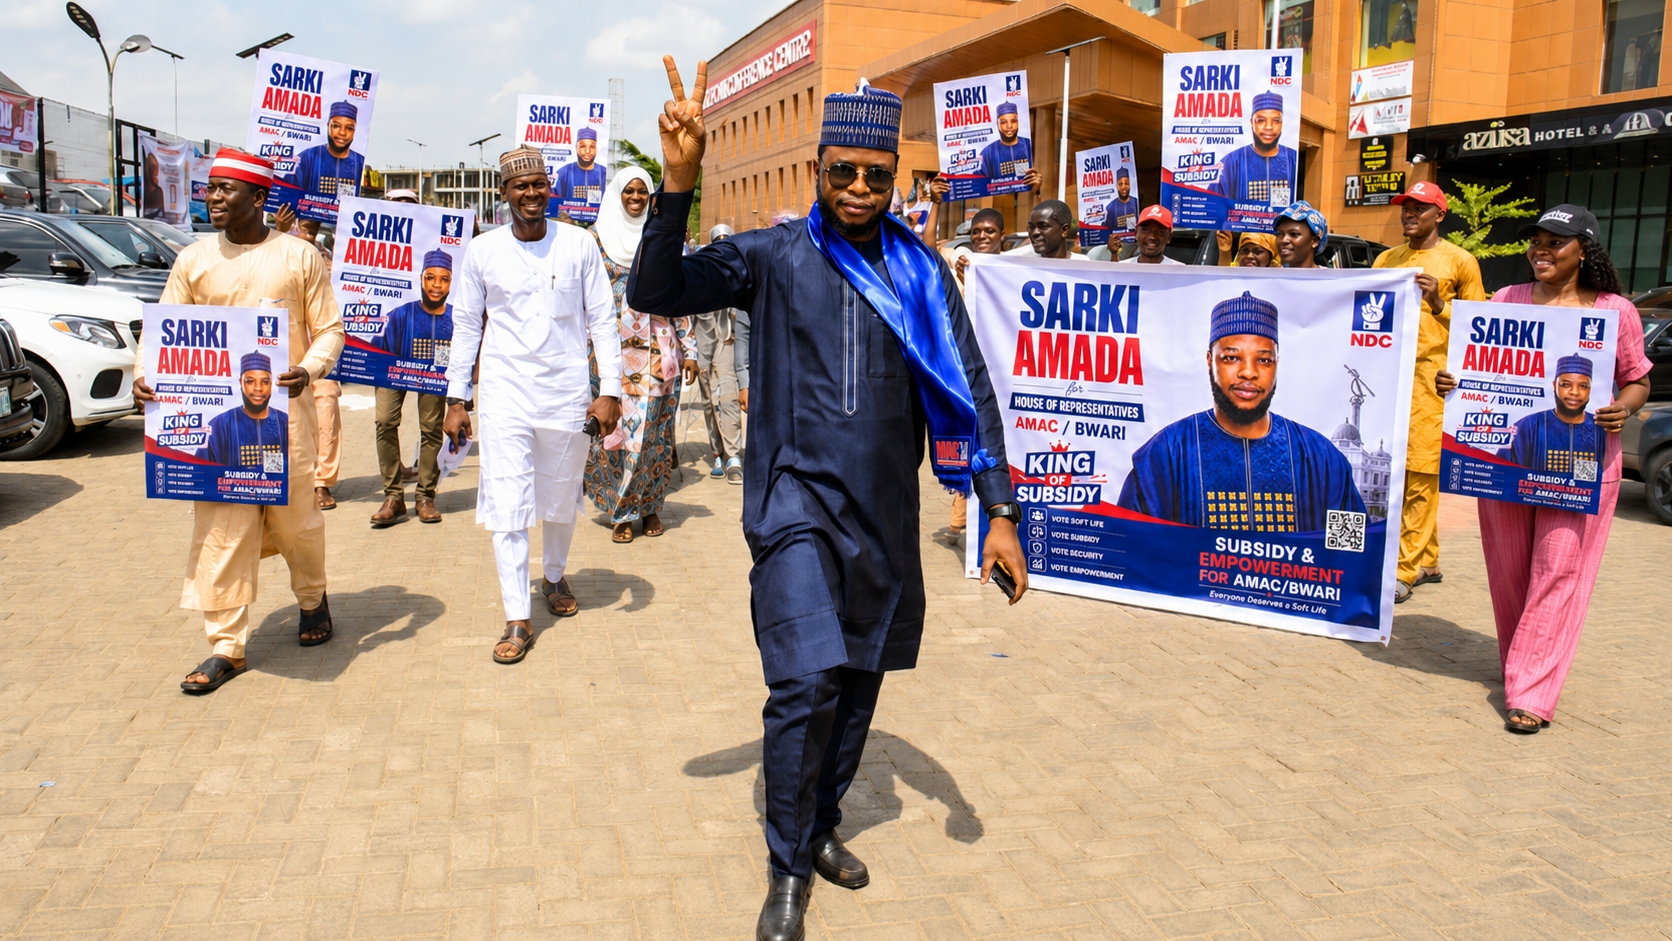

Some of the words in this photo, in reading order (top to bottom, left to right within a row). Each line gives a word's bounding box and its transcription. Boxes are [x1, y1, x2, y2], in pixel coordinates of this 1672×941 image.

[270, 63, 323, 94] SARKI
[1180, 65, 1240, 91] SARKI
[1271, 77, 1291, 85] NDC
[348, 89, 368, 98] NDC
[945, 85, 987, 108] SARKI
[262, 87, 321, 119] AMADA
[1174, 92, 1243, 118] AMADA
[529, 104, 570, 125] SARKI
[944, 105, 992, 129] AMADA
[524, 124, 572, 144] AMADA
[1175, 136, 1198, 144] AMAC
[1534, 126, 1584, 142] HOTEL
[262, 146, 291, 156] KING
[1084, 154, 1111, 173] SARKI
[1180, 154, 1212, 166] KING
[1082, 170, 1114, 188] AMADA
[352, 211, 413, 244] SARKI
[440, 237, 461, 246] NDC
[344, 238, 413, 272] AMADA
[342, 284, 365, 293] AMAC
[374, 288, 402, 298] BWARI
[345, 305, 378, 316] KING
[1020, 280, 1140, 334] SARKI
[161, 318, 227, 348] SARKI
[344, 322, 382, 332] UBSIDY
[1470, 316, 1545, 349] SARKI
[257, 338, 278, 346] NDC
[1350, 333, 1393, 348] NDC
[1579, 341, 1603, 350] NDC
[157, 347, 232, 377] AMADA
[1012, 330, 1144, 385] AMADA
[1462, 344, 1545, 378] AMADA
[1065, 381, 1084, 396] for
[158, 395, 183, 404] AMAC
[192, 397, 223, 406] BWARI
[1014, 396, 1044, 410] HOUSE
[1046, 399, 1058, 410] OF
[1059, 400, 1139, 419] REPRESENTATIVES
[1461, 392, 1488, 403] AMAC
[1498, 396, 1533, 407] BWARI
[165, 415, 199, 428] KING
[1015, 416, 1059, 433] AMAC
[1062, 421, 1070, 436] /
[1075, 422, 1126, 440] BWARI
[1466, 414, 1504, 426] KING
[159, 434, 204, 446] SUBSIDY
[1457, 432, 1509, 443] SUBSIDY
[1028, 453, 1091, 475] KING
[1049, 475, 1066, 485] OF
[1016, 486, 1099, 503] SUBSIDY
[1051, 515, 1069, 523] VOTE
[1071, 517, 1088, 526] SOFT
[1090, 520, 1104, 528] LIFE
[1051, 531, 1069, 540] VOTE
[1051, 547, 1069, 556] VOTE
[1070, 550, 1104, 560] SECURITY
[1215, 537, 1298, 563] SUBSIDY
[1301, 548, 1315, 564] &
[1050, 564, 1069, 572] VOTE
[1069, 566, 1124, 580] EMPOWERMENT
[1199, 552, 1344, 584] EMPOWERMENT
[1199, 569, 1228, 585] FOR
[1233, 574, 1341, 601] AMAC/BWARI
[1209, 590, 1245, 603] Everyone
[1247, 596, 1283, 609] Deserves
[1292, 603, 1309, 613] Soft
[1311, 604, 1327, 615] Life
